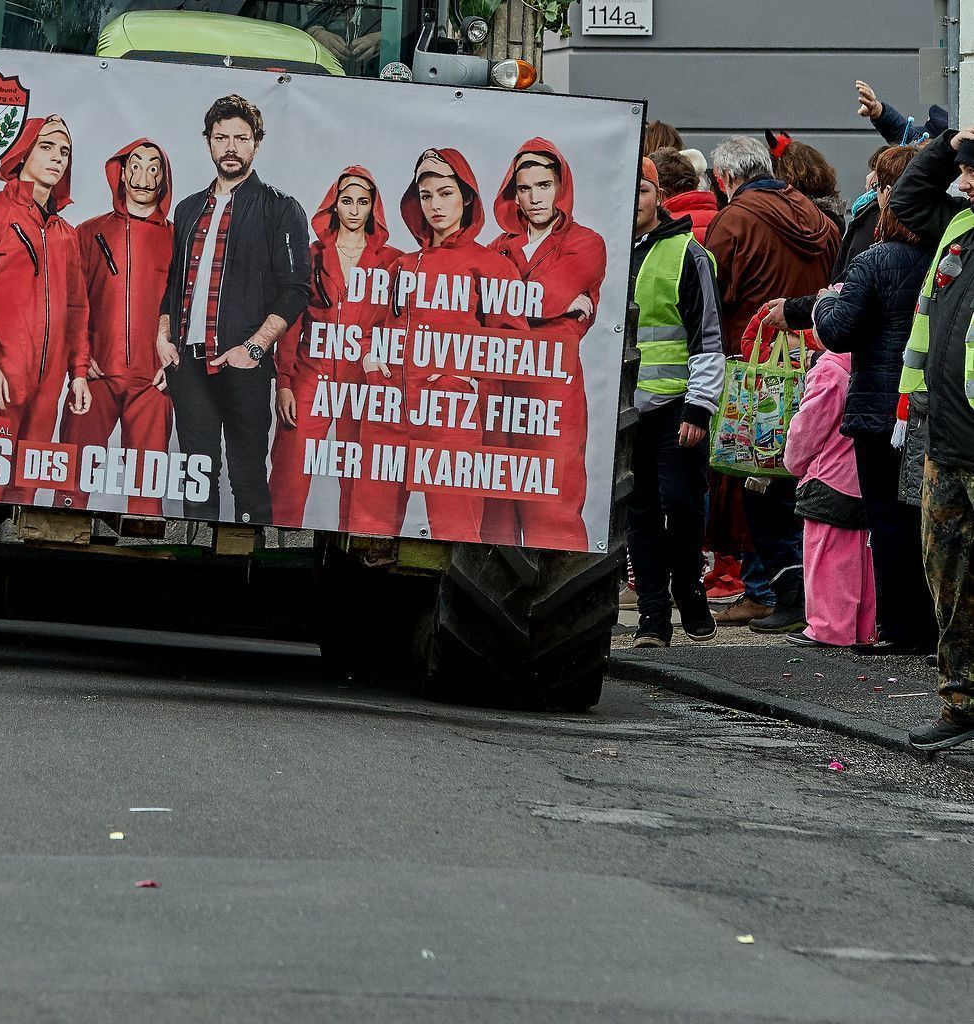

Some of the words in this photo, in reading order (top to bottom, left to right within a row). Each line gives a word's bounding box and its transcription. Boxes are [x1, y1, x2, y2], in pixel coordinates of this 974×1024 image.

[588, 5, 637, 26] 114a
[397, 270, 471, 312] PLAN
[480, 276, 545, 318] WOR
[309, 322, 363, 362] ENS
[370, 326, 407, 365] NE
[412, 324, 574, 384] ÜVVERFALL,
[310, 374, 403, 424] ÄVVER
[409, 389, 479, 430] JETZ
[485, 395, 563, 437] FIERE
[23, 448, 69, 483] DES
[79, 444, 213, 503] GELDES
[303, 438, 364, 480] MER
[371, 443, 407, 483] IM
[412, 447, 559, 496] KARNEVAL
